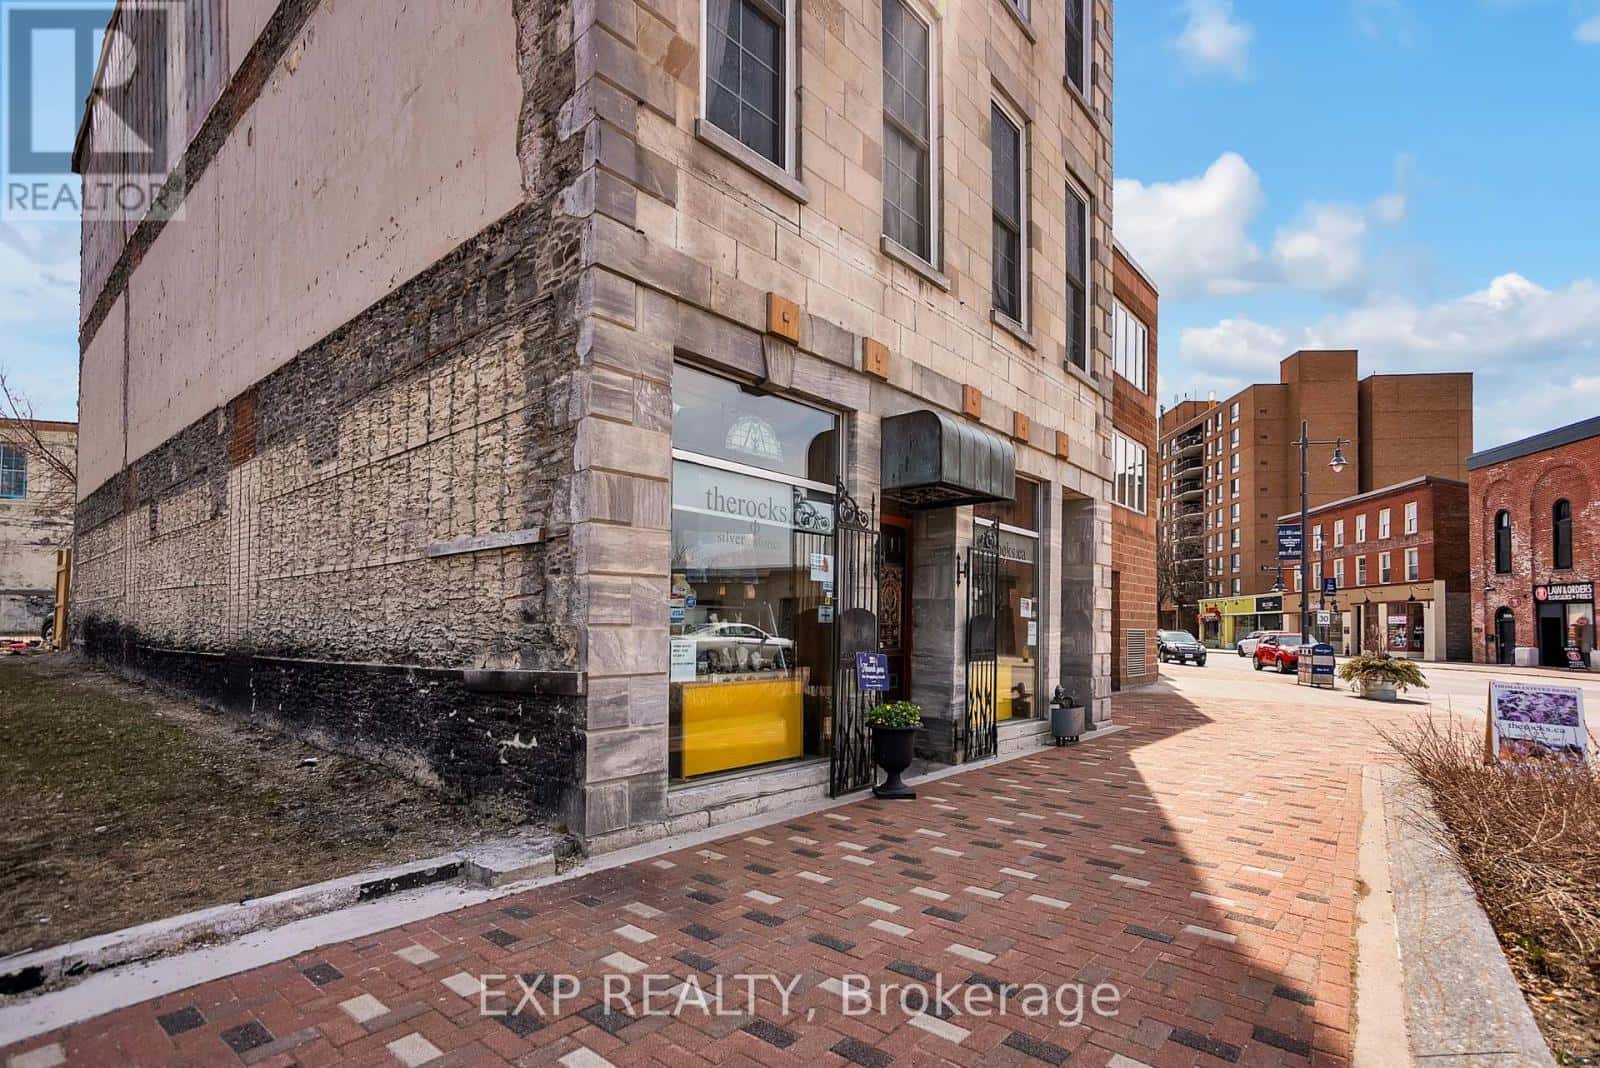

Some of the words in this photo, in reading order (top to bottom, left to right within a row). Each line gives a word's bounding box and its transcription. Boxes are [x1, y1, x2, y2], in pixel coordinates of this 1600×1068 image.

[705, 486, 788, 523] therocks
[1547, 585, 1562, 595] LAW
[1567, 584, 1593, 594] ORDERS
